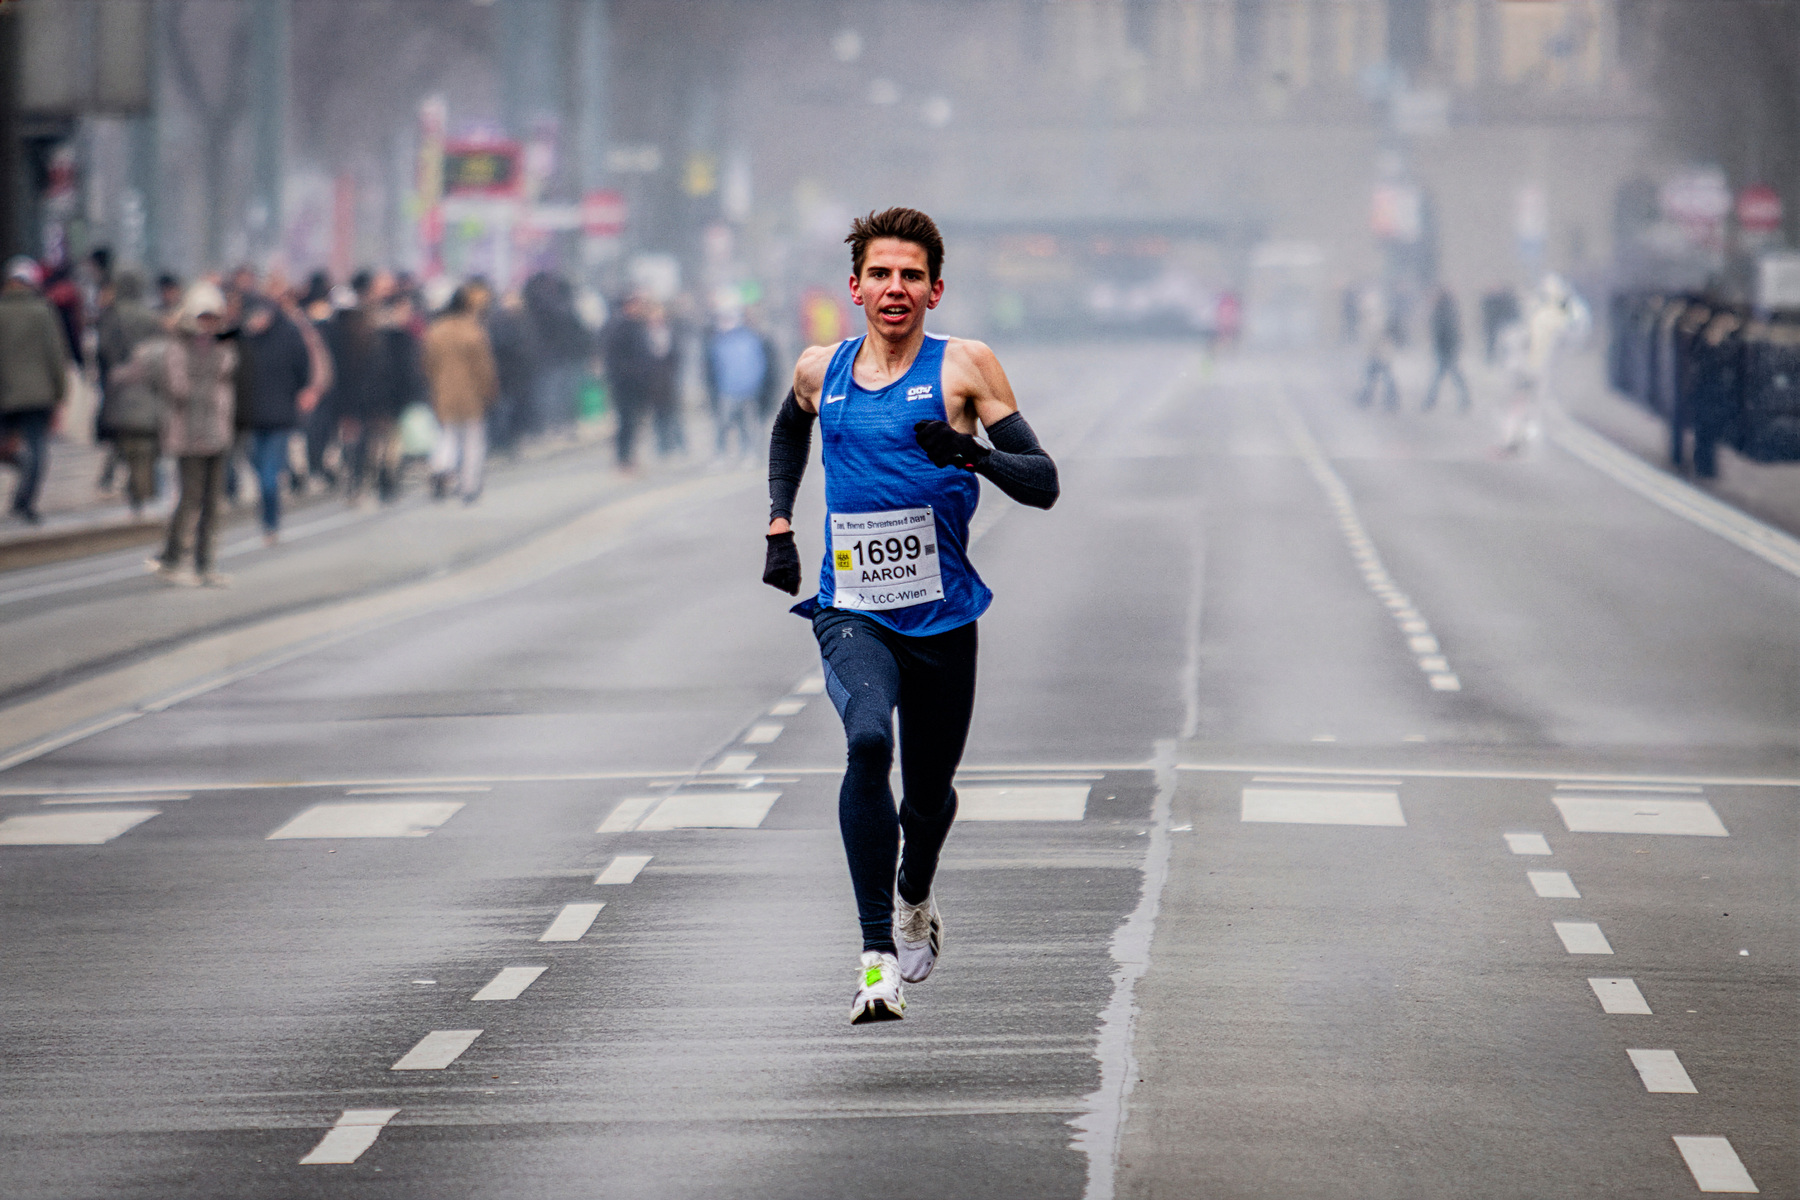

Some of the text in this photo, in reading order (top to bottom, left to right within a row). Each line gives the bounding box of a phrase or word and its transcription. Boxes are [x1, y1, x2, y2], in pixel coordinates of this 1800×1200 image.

[853, 535, 921, 565] 1699
[861, 564, 917, 582] AARON
[872, 589, 927, 604] LCC-Wien
